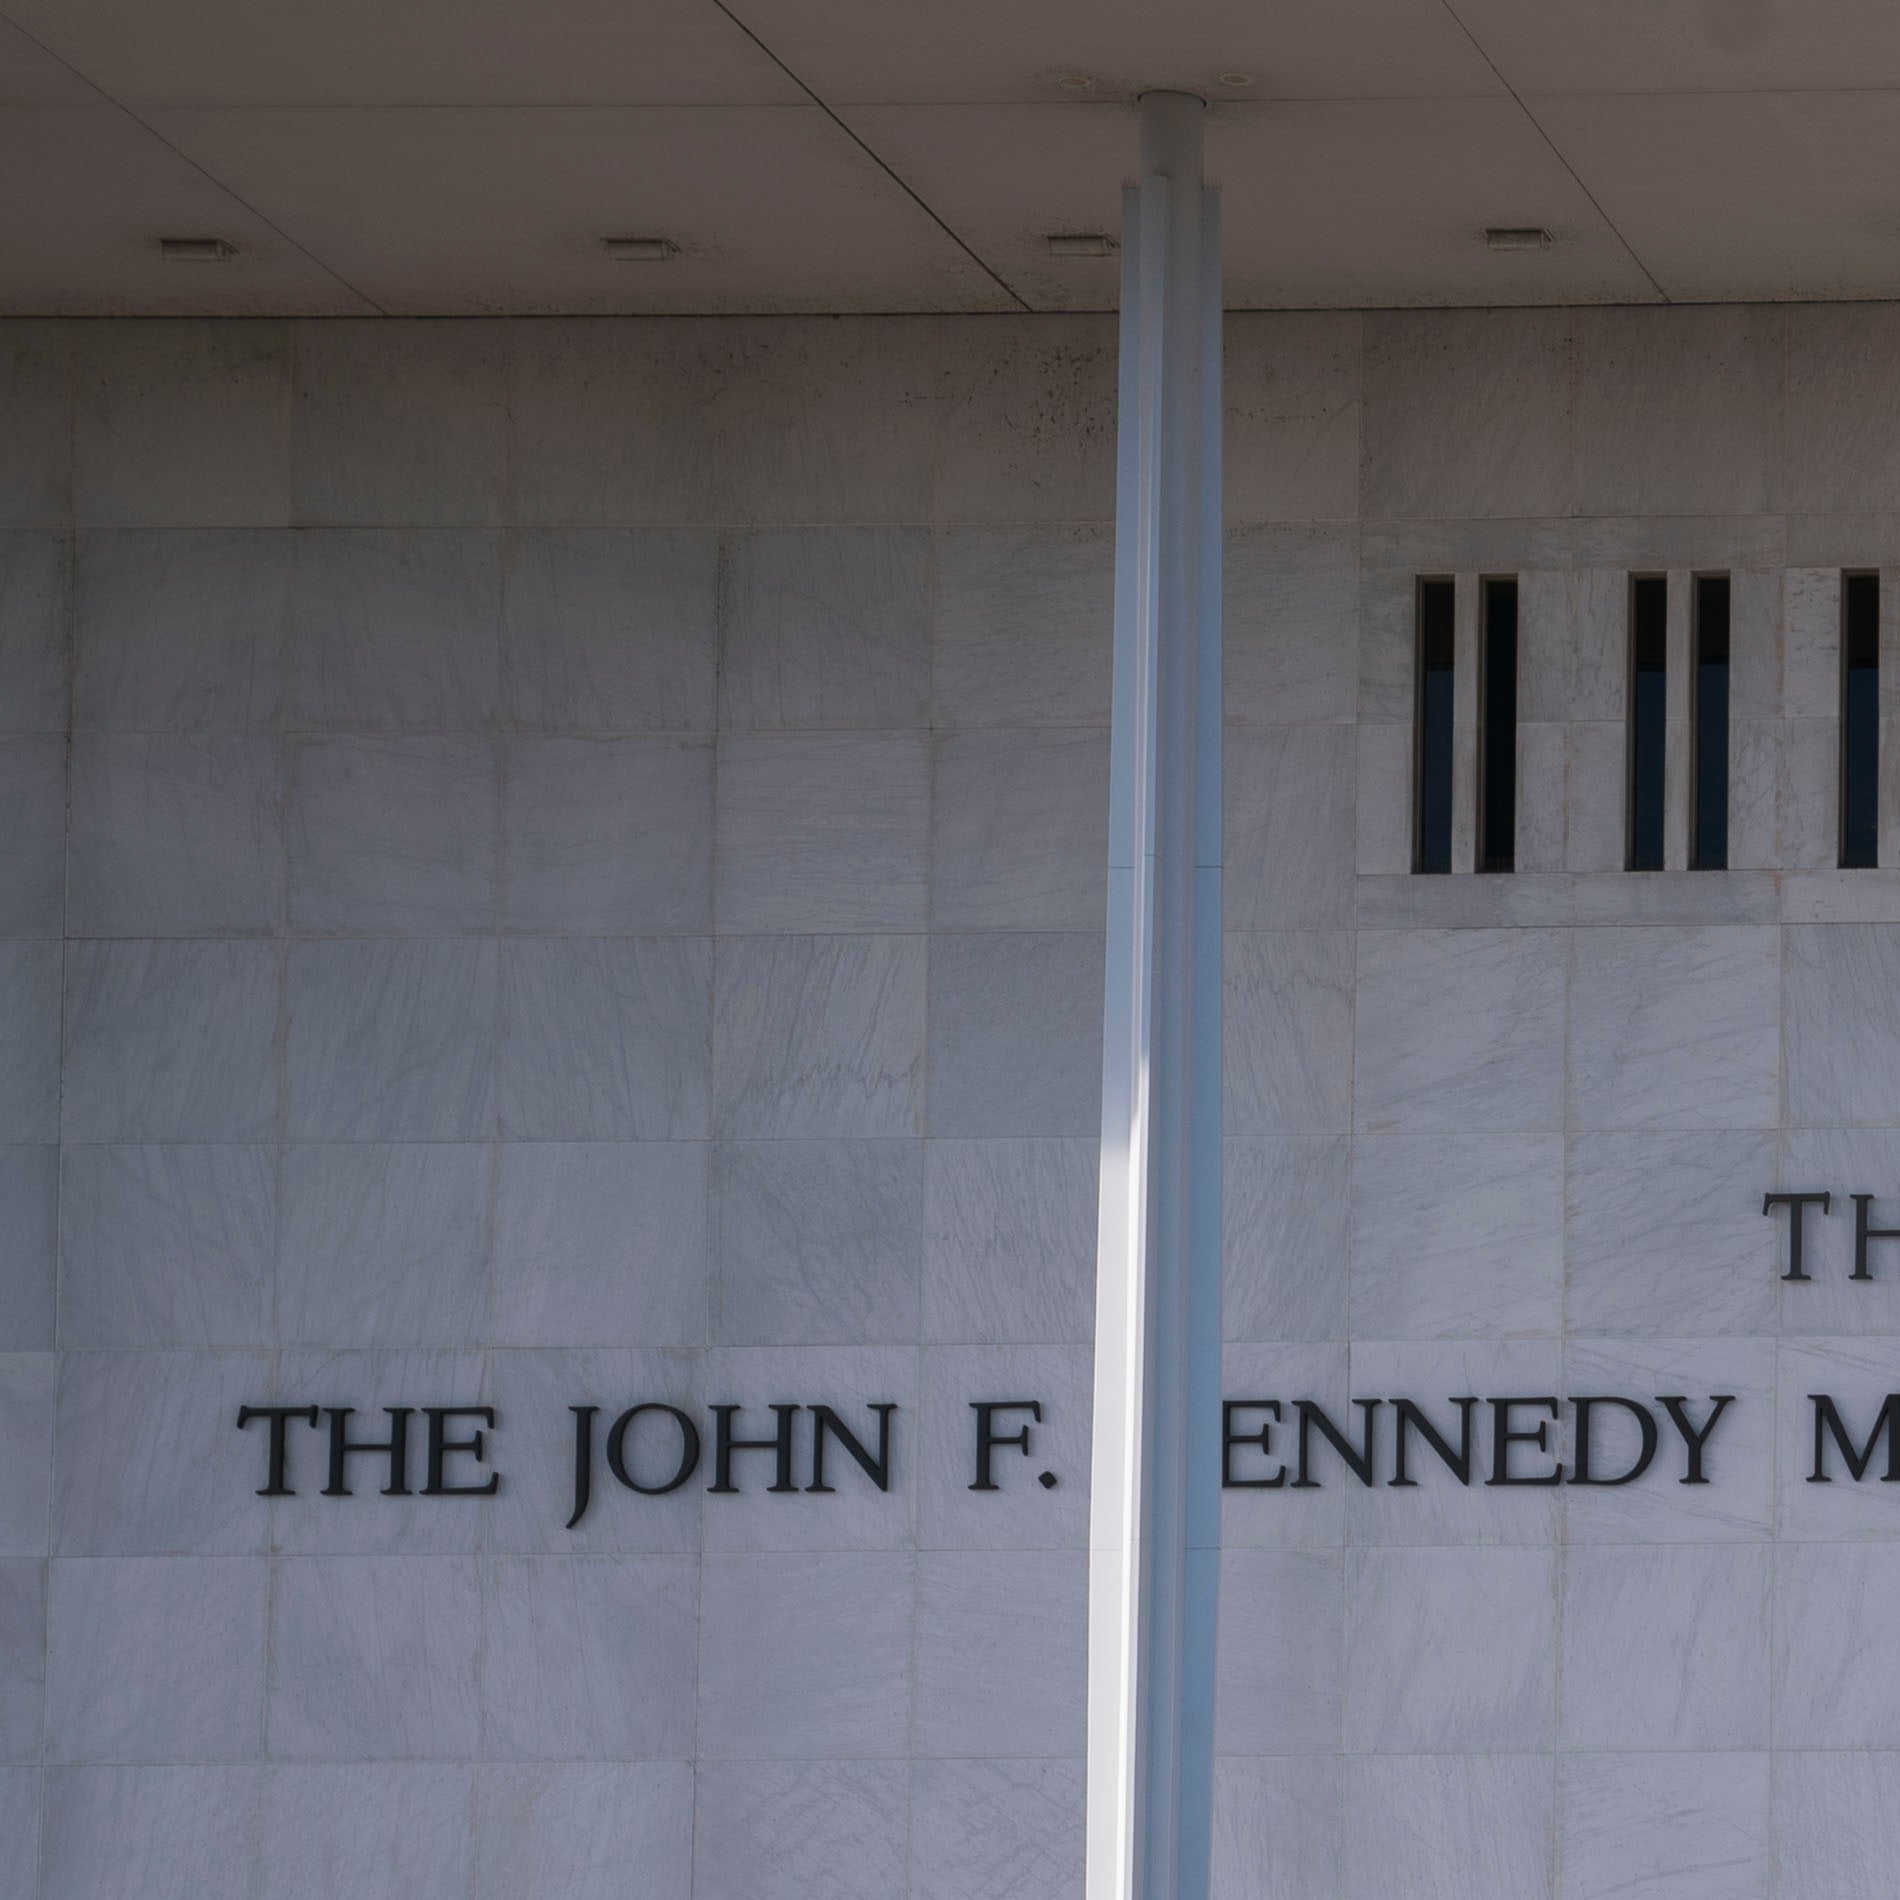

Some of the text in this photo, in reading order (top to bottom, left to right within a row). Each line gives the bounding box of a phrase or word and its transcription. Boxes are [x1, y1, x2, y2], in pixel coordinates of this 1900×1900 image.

[237, 1405, 499, 1497] THE
[566, 1403, 897, 1529] JOHN
[968, 1401, 1057, 1490] F.
[1222, 1396, 1735, 1488] ENNEDY
